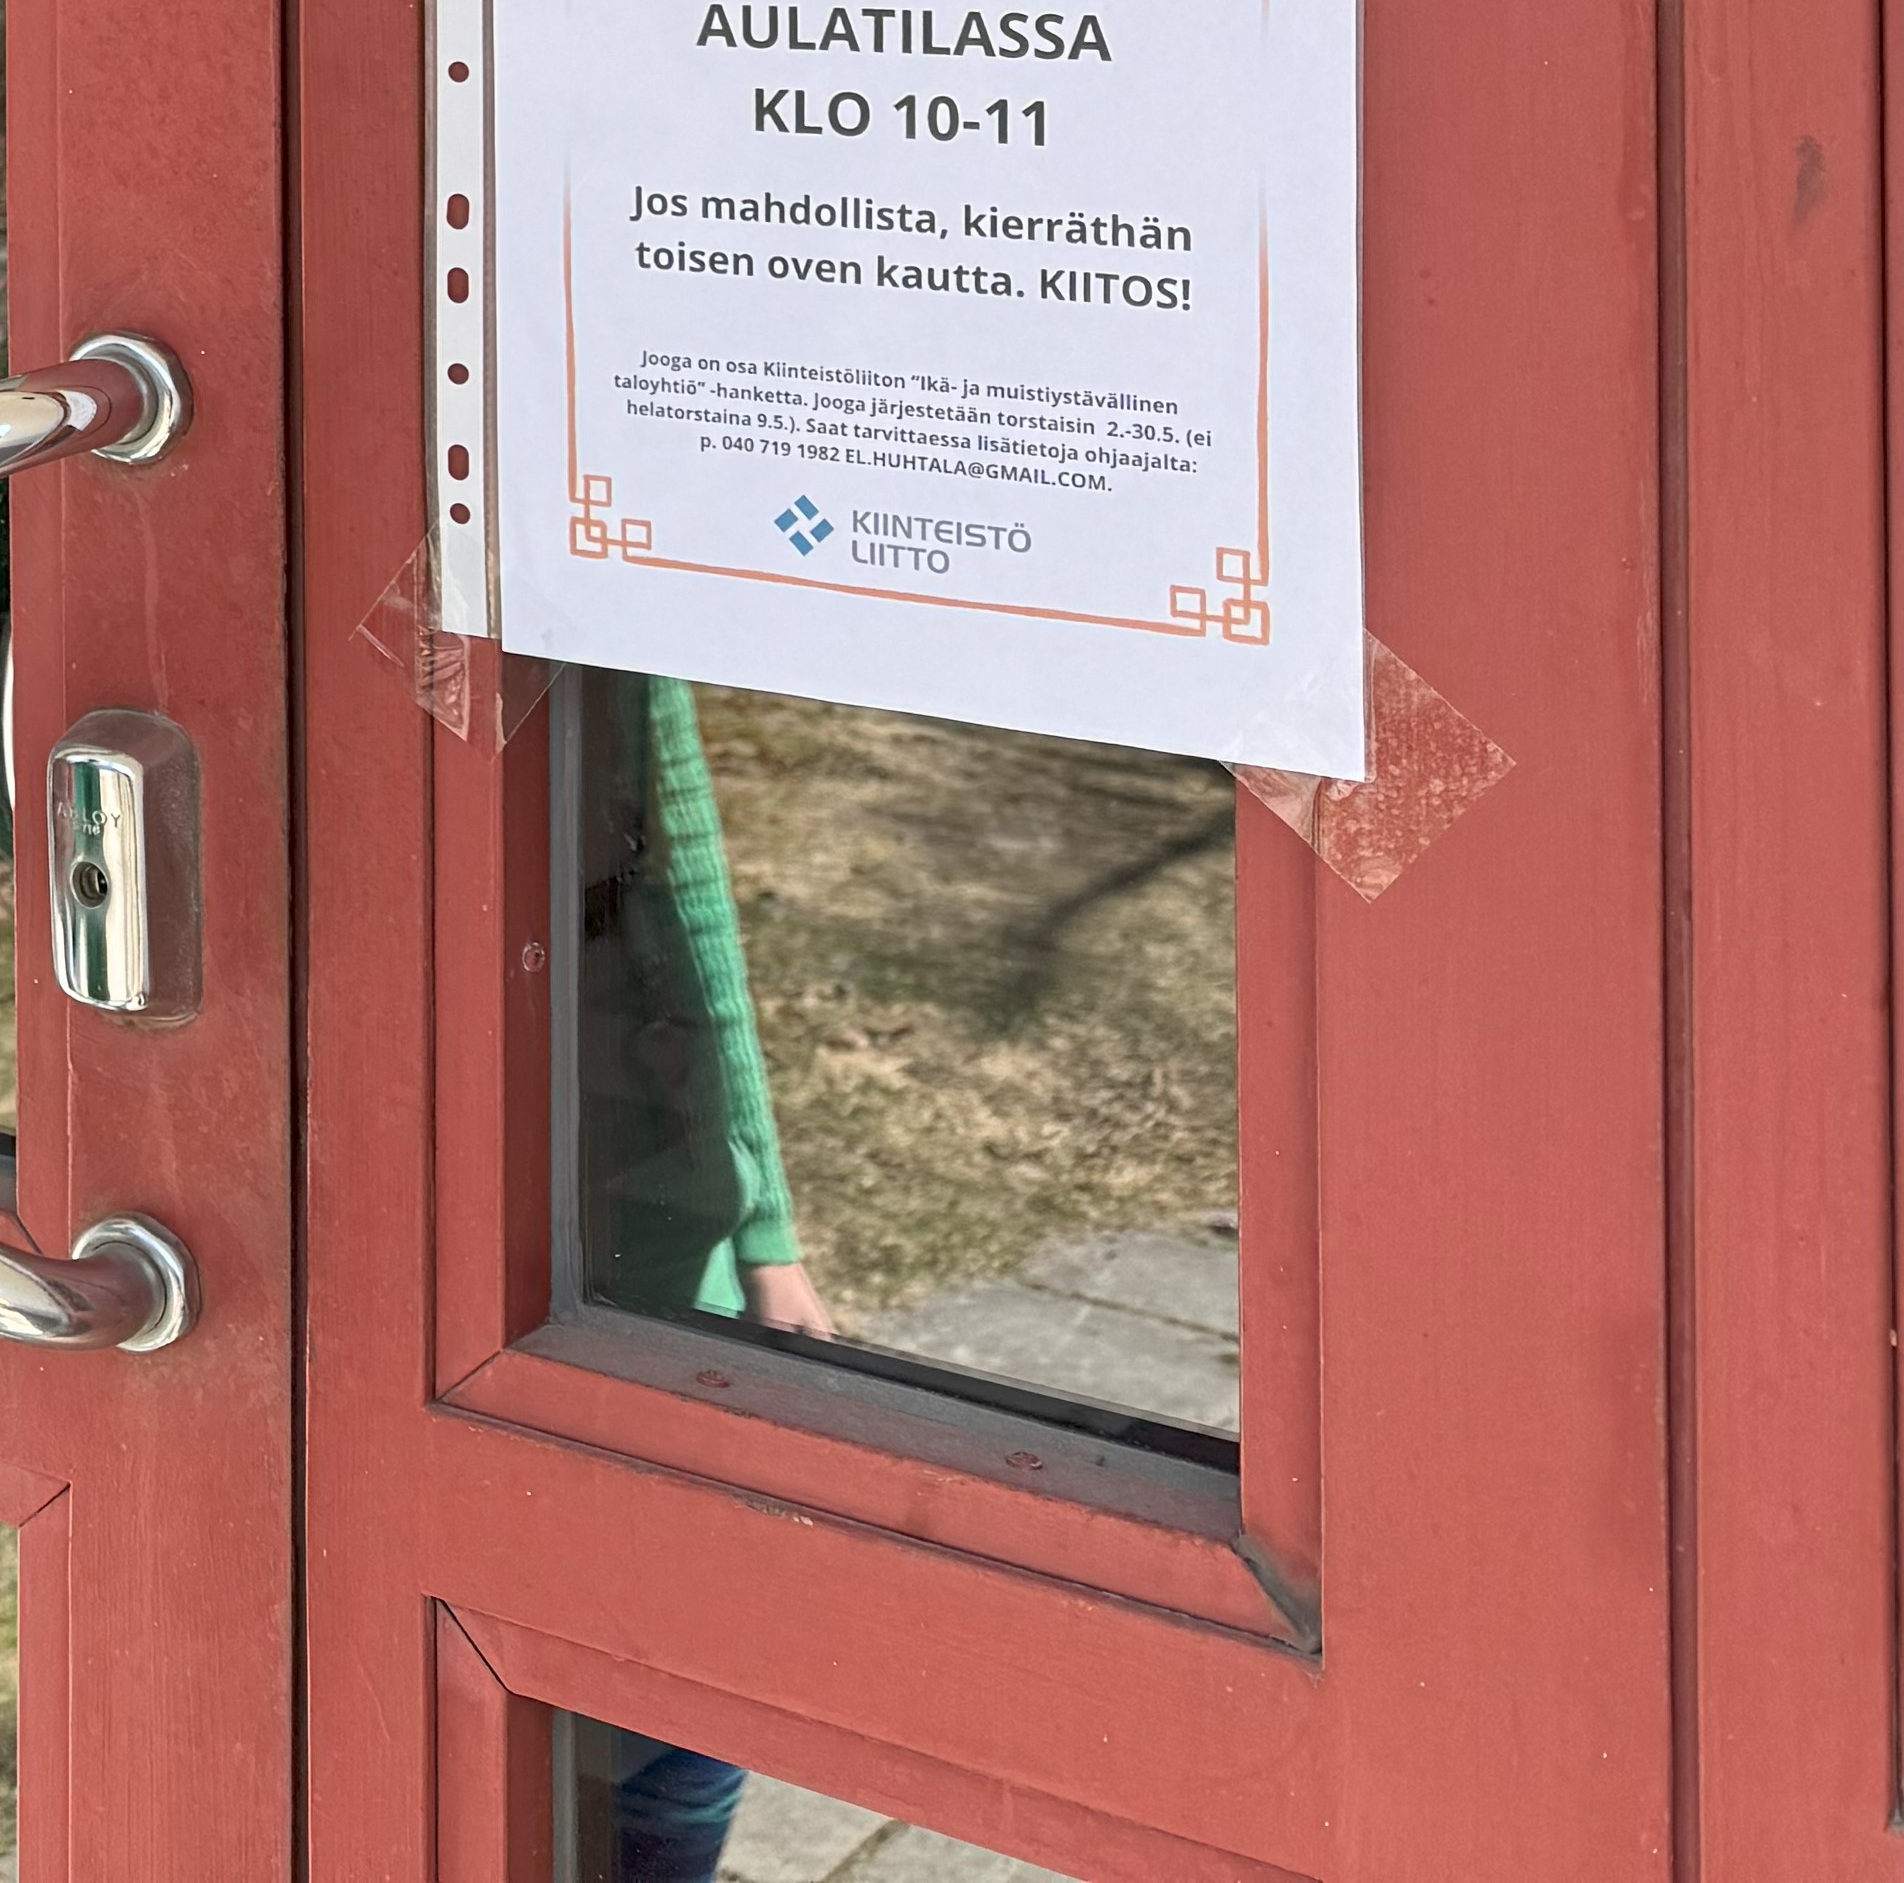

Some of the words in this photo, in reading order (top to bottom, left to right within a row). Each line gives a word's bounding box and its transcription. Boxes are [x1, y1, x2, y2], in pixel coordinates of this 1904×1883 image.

[695, 3, 1113, 62] AULATILASSA
[754, 87, 871, 137] KLO
[893, 94, 1045, 147] 10-11
[629, 185, 688, 222] Jos
[701, 191, 948, 240] mahdollista,
[964, 204, 1192, 252] kierräthän
[634, 240, 754, 277] toisen
[767, 255, 862, 285] oven
[876, 254, 1025, 298] kautta.
[1040, 268, 1191, 312] KIITOS!
[639, 349, 692, 372] Jooga
[697, 358, 720, 372] on
[725, 360, 758, 375] osa
[763, 361, 906, 390] Kiinteistöliiton
[960, 378, 980, 400] ja
[986, 384, 1178, 415] muistiystävällinen
[626, 398, 752, 427] helatorstaina
[757, 412, 801, 435] 9.5.).
[805, 417, 849, 437] Saat
[853, 423, 971, 450] tarvittaessa
[977, 434, 1079, 464] lisätietoja
[1084, 446, 1197, 474] ohjaajalta:
[709, 382, 808, 407] -hanketta.
[811, 392, 866, 415] Jooga
[869, 397, 991, 425] järjestetään
[997, 411, 1095, 436] torstaisin
[1106, 420, 1180, 444] 2.-30.5.
[1186, 429, 1212, 448] (ei
[700, 436, 717, 453] p.
[722, 435, 755, 453] 040
[759, 438, 792, 457] 719
[797, 443, 841, 463] 1982
[845, 448, 1113, 492] EL.HUHTALA@GMAIL.COM.
[851, 539, 950, 574] LIITTO
[852, 509, 1032, 553] KIINTEISTÖ
